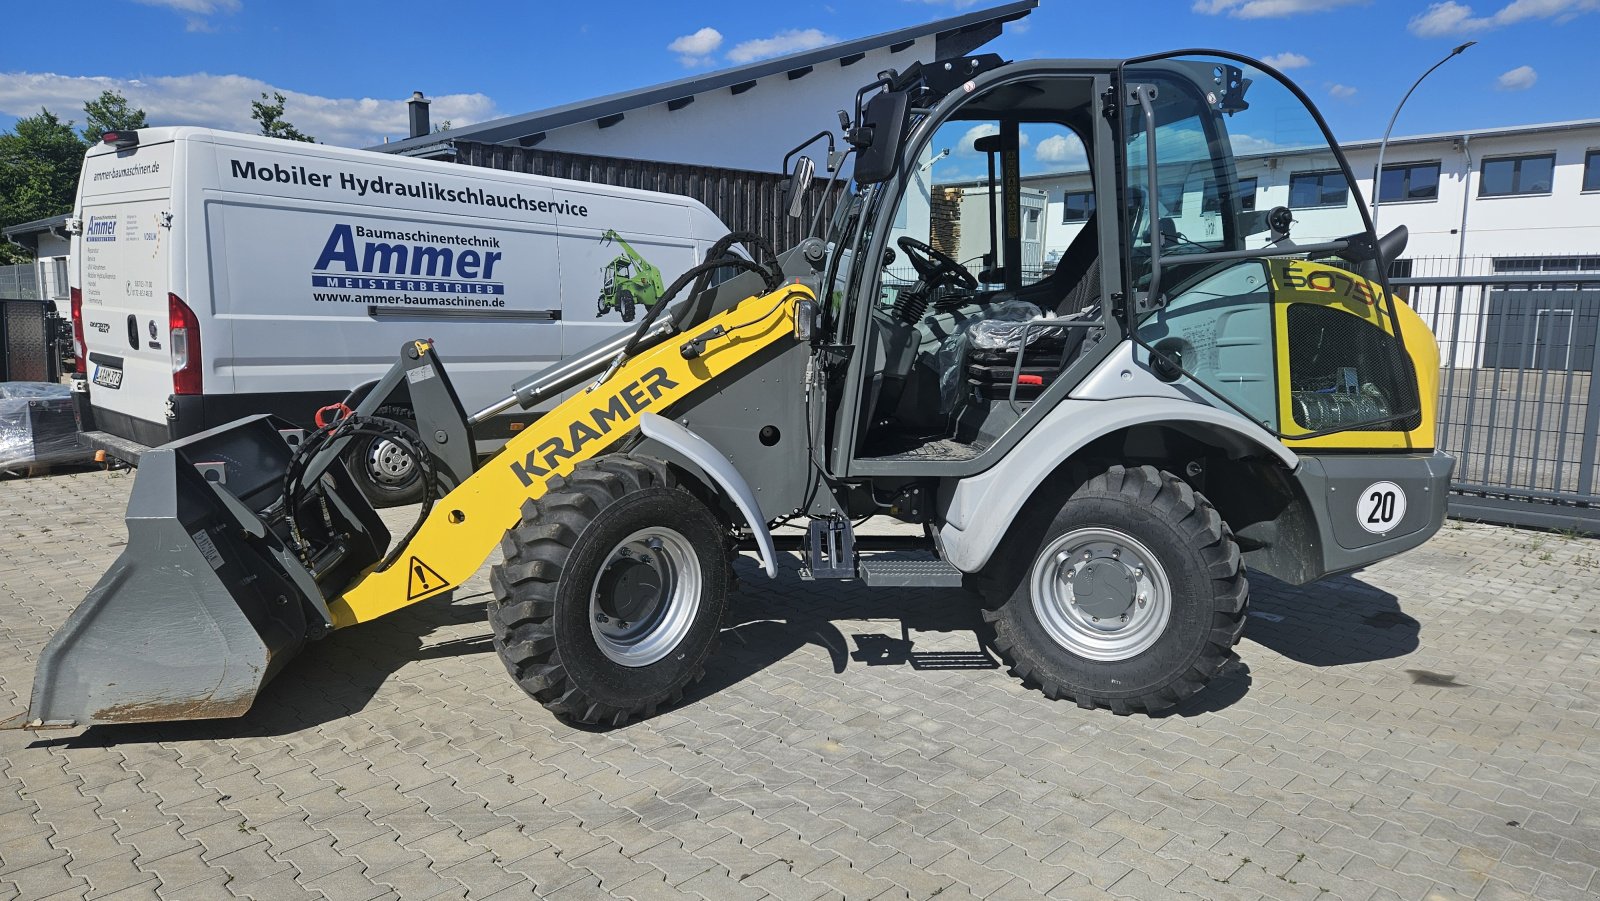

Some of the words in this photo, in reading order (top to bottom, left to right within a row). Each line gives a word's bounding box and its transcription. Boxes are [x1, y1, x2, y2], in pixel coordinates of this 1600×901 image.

[93, 161, 160, 182] ammer-baumaschinen.de
[230, 159, 332, 189] Mobiler
[340, 172, 588, 218] Hydraulikschlauchservice
[87, 215, 117, 236] Ammer
[355, 225, 500, 249] Baumaschinentechnik
[313, 223, 502, 280] Ammer
[326, 278, 495, 294] MEISTERBETRIEB
[312, 291, 505, 308] www.ammer-baumaschinen.de
[510, 366, 680, 488] KRAMER
[1367, 490, 1395, 524] 20
